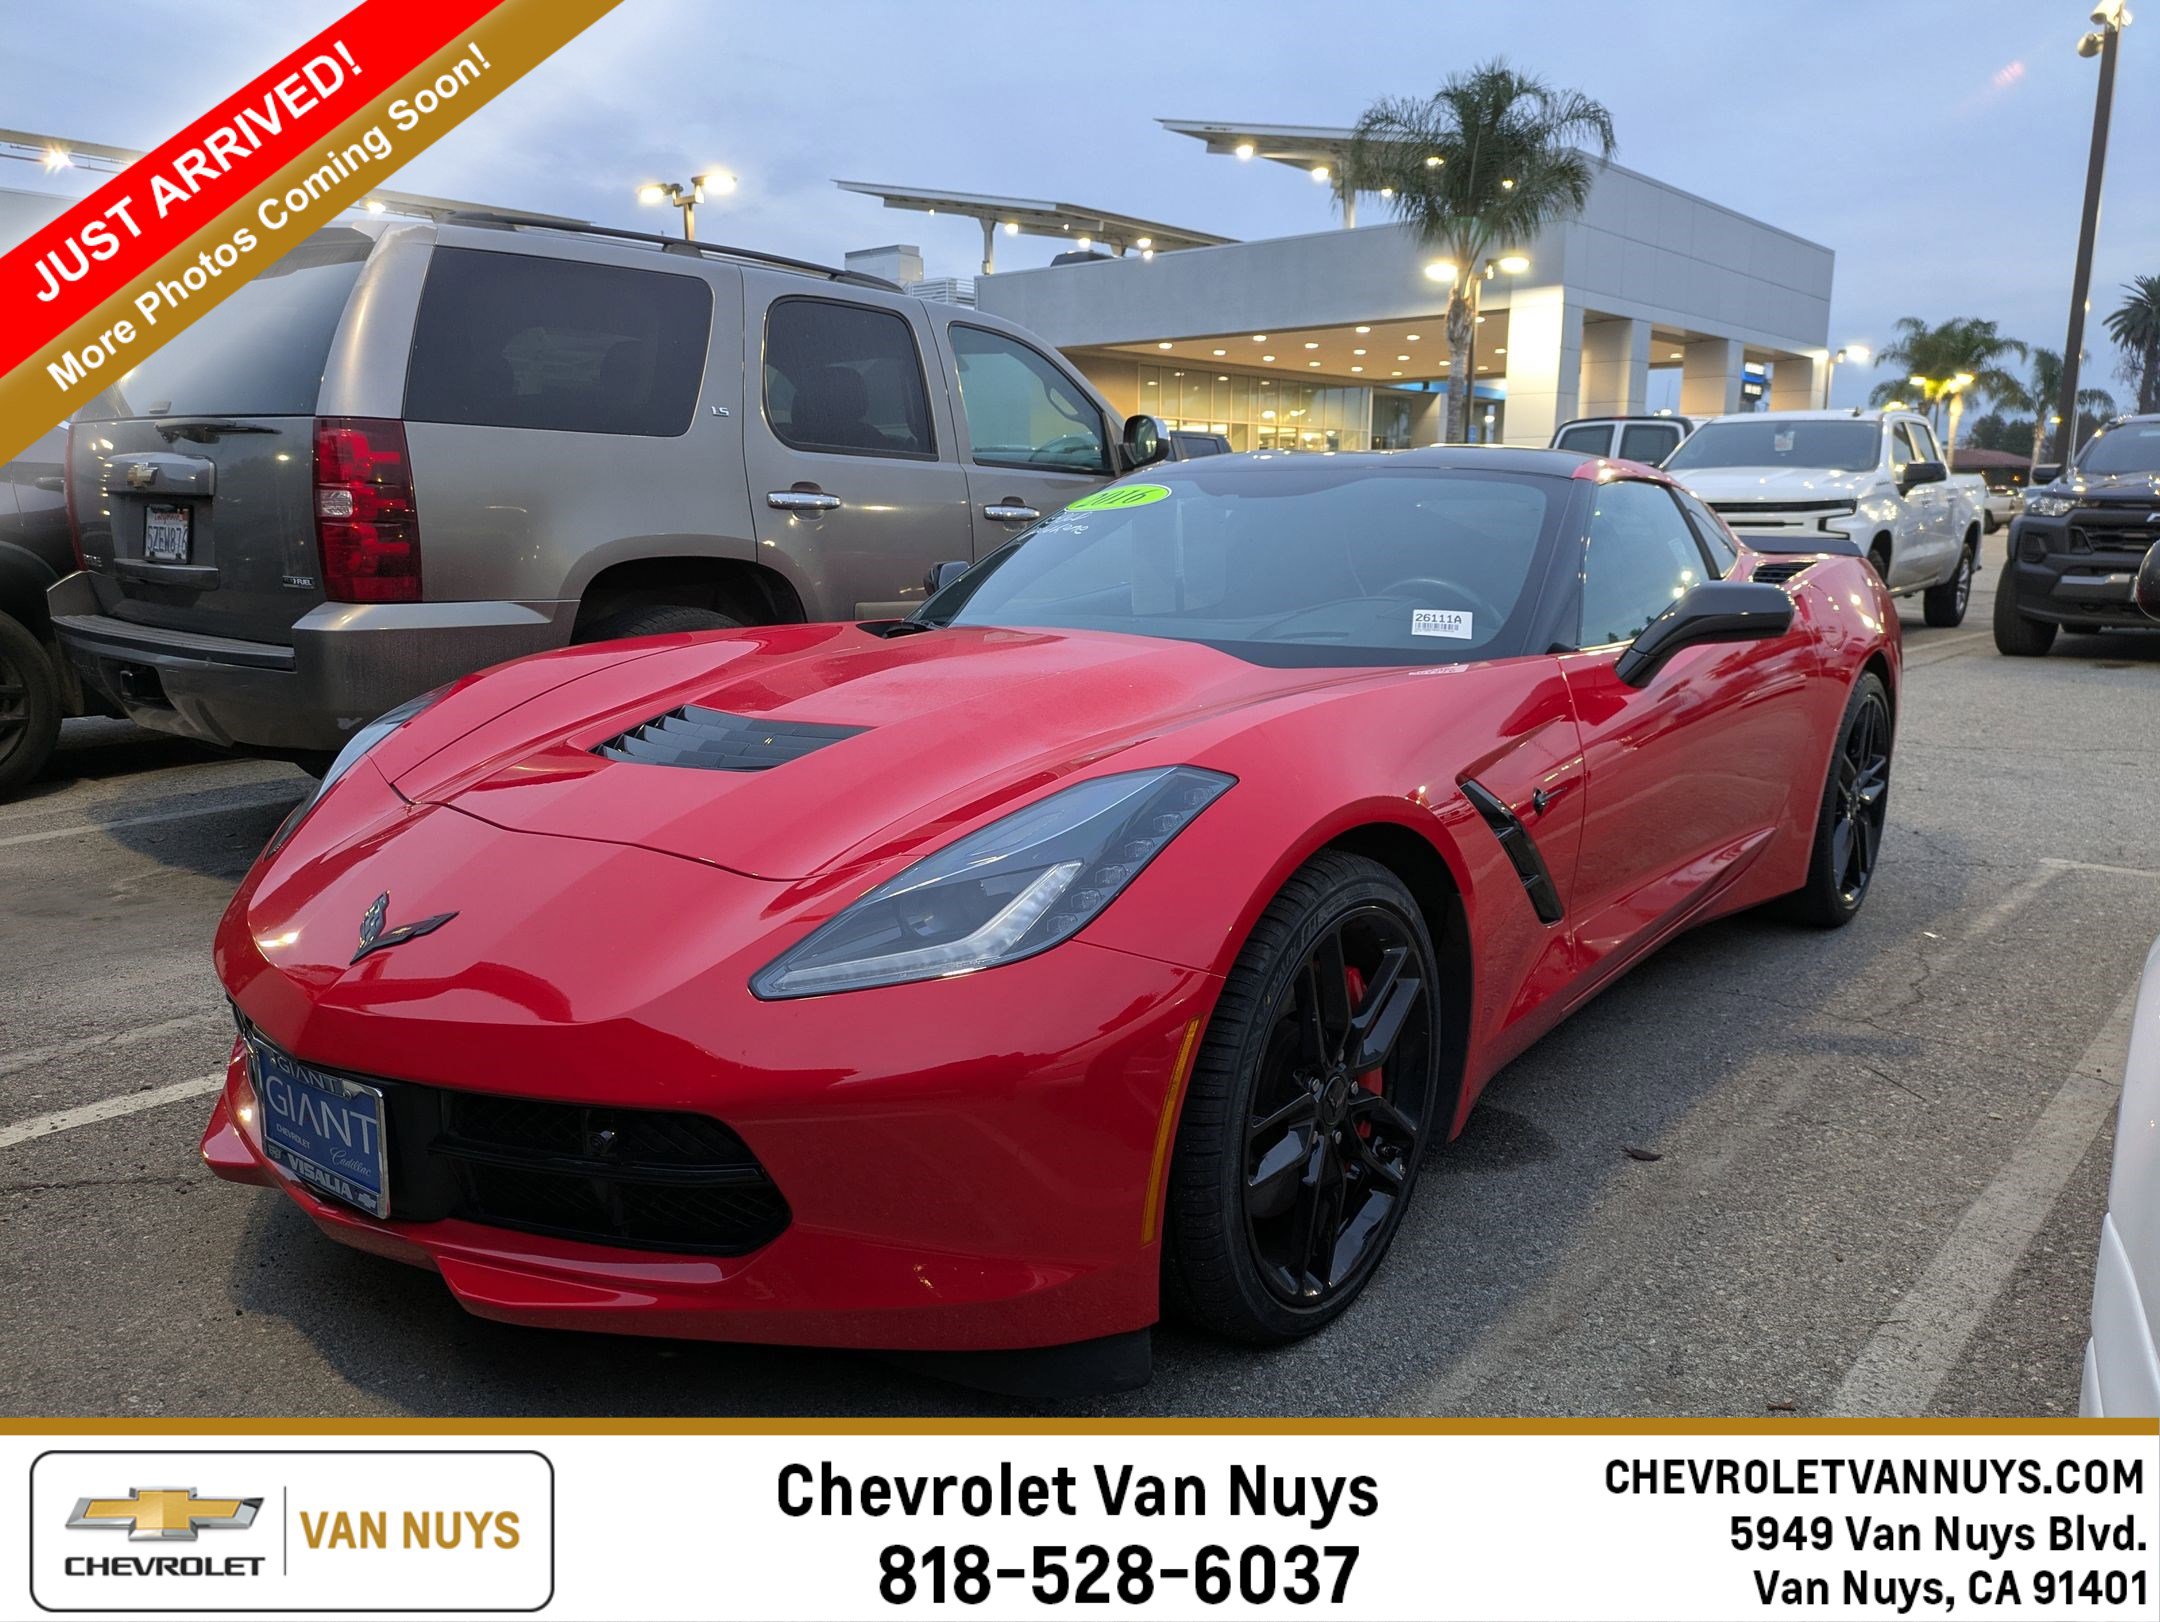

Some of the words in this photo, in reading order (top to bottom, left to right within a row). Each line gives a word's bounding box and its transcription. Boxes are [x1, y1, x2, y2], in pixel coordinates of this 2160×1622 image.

[1415, 613, 1462, 625] 26111A
[277, 1056, 338, 1093] GIANT
[265, 1075, 377, 1155] GIANT
[276, 1123, 311, 1150] CHEVROLET
[287, 1153, 354, 1201] VISALIA
[330, 1146, 373, 1177] Cadillac
